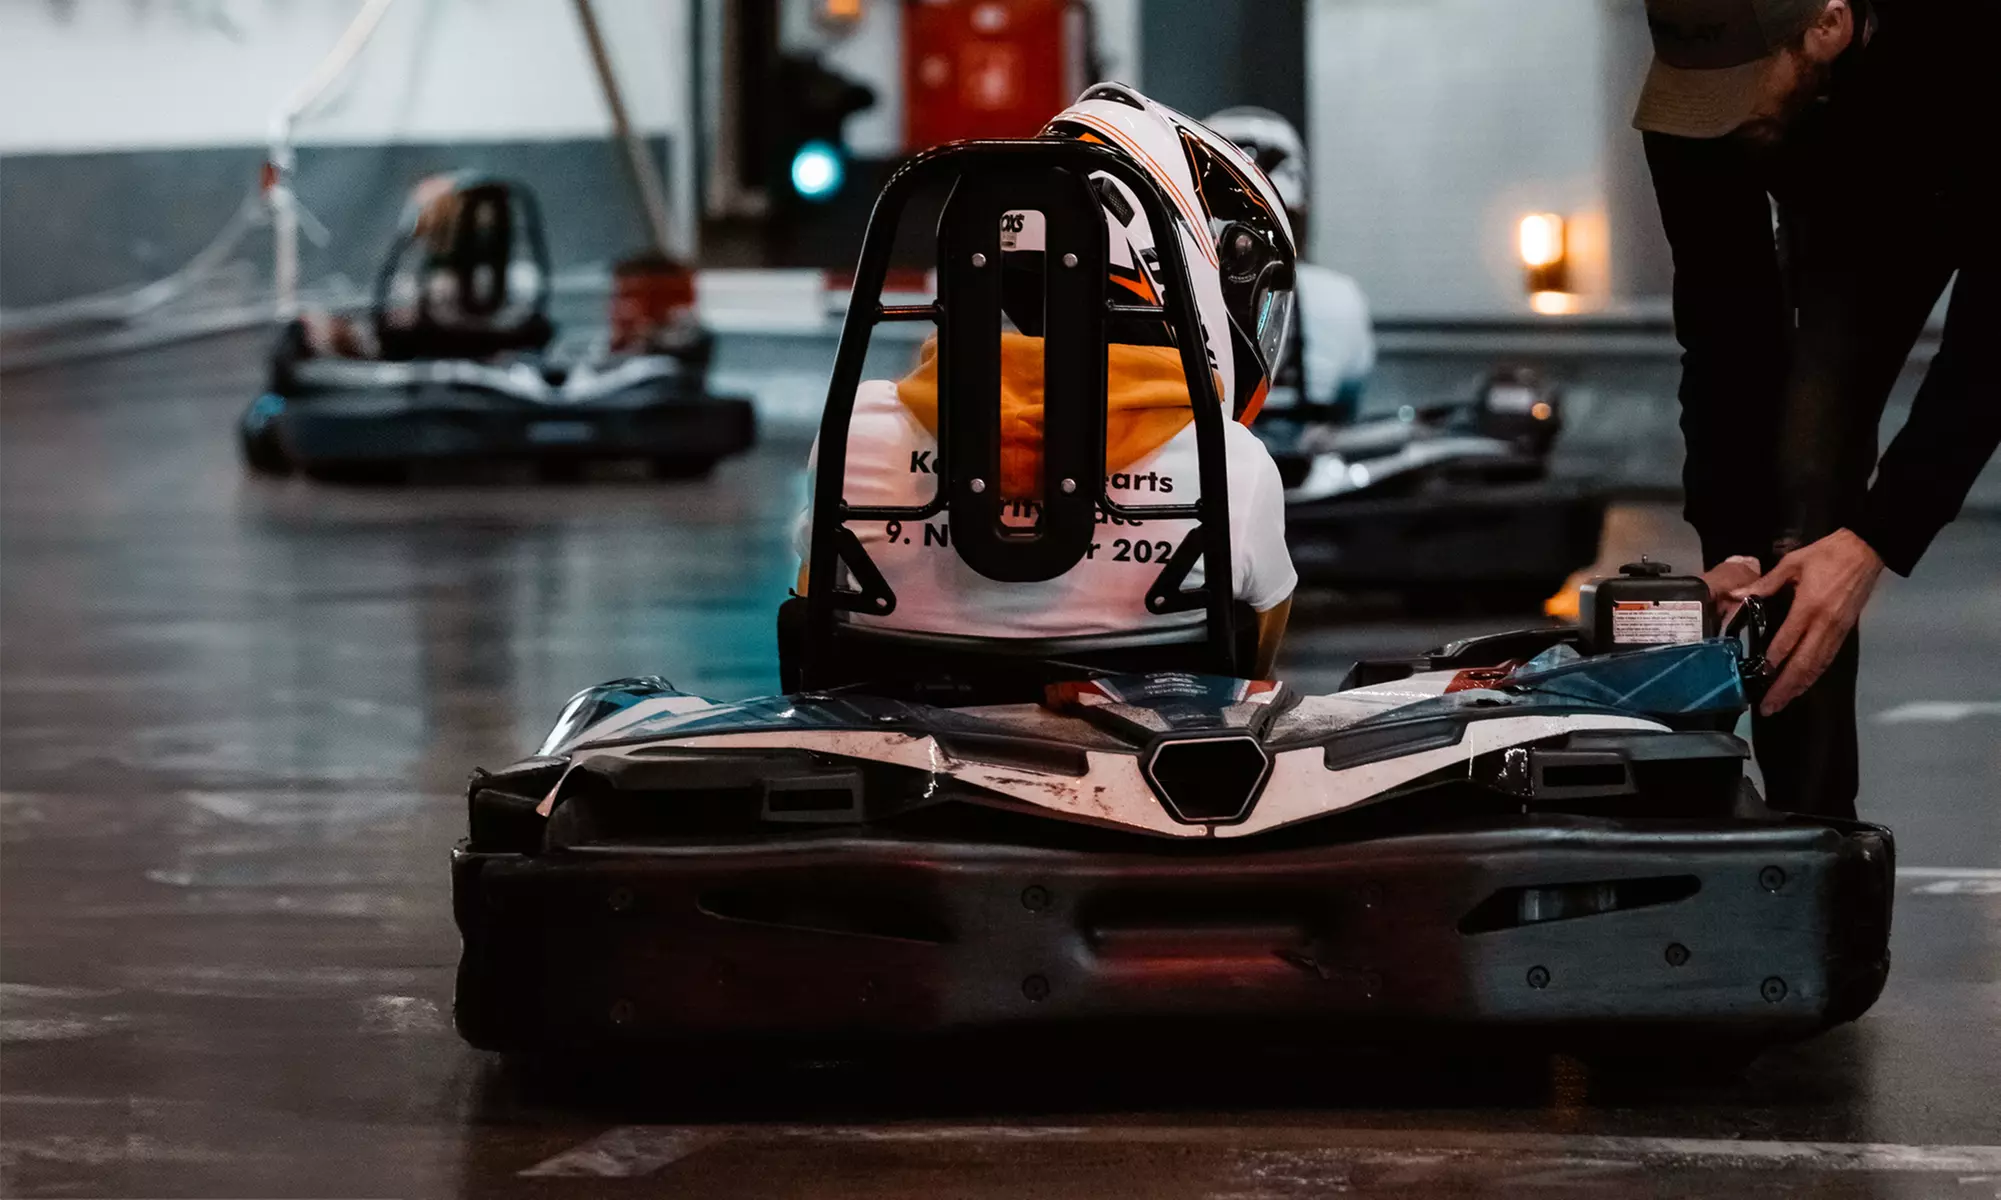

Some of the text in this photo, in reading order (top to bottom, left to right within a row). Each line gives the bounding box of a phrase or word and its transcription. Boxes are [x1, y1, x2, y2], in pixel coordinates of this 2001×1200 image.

[1105, 471, 1174, 493] arts
[886, 520, 910, 544] 9.
[1112, 538, 1172, 563] 202
